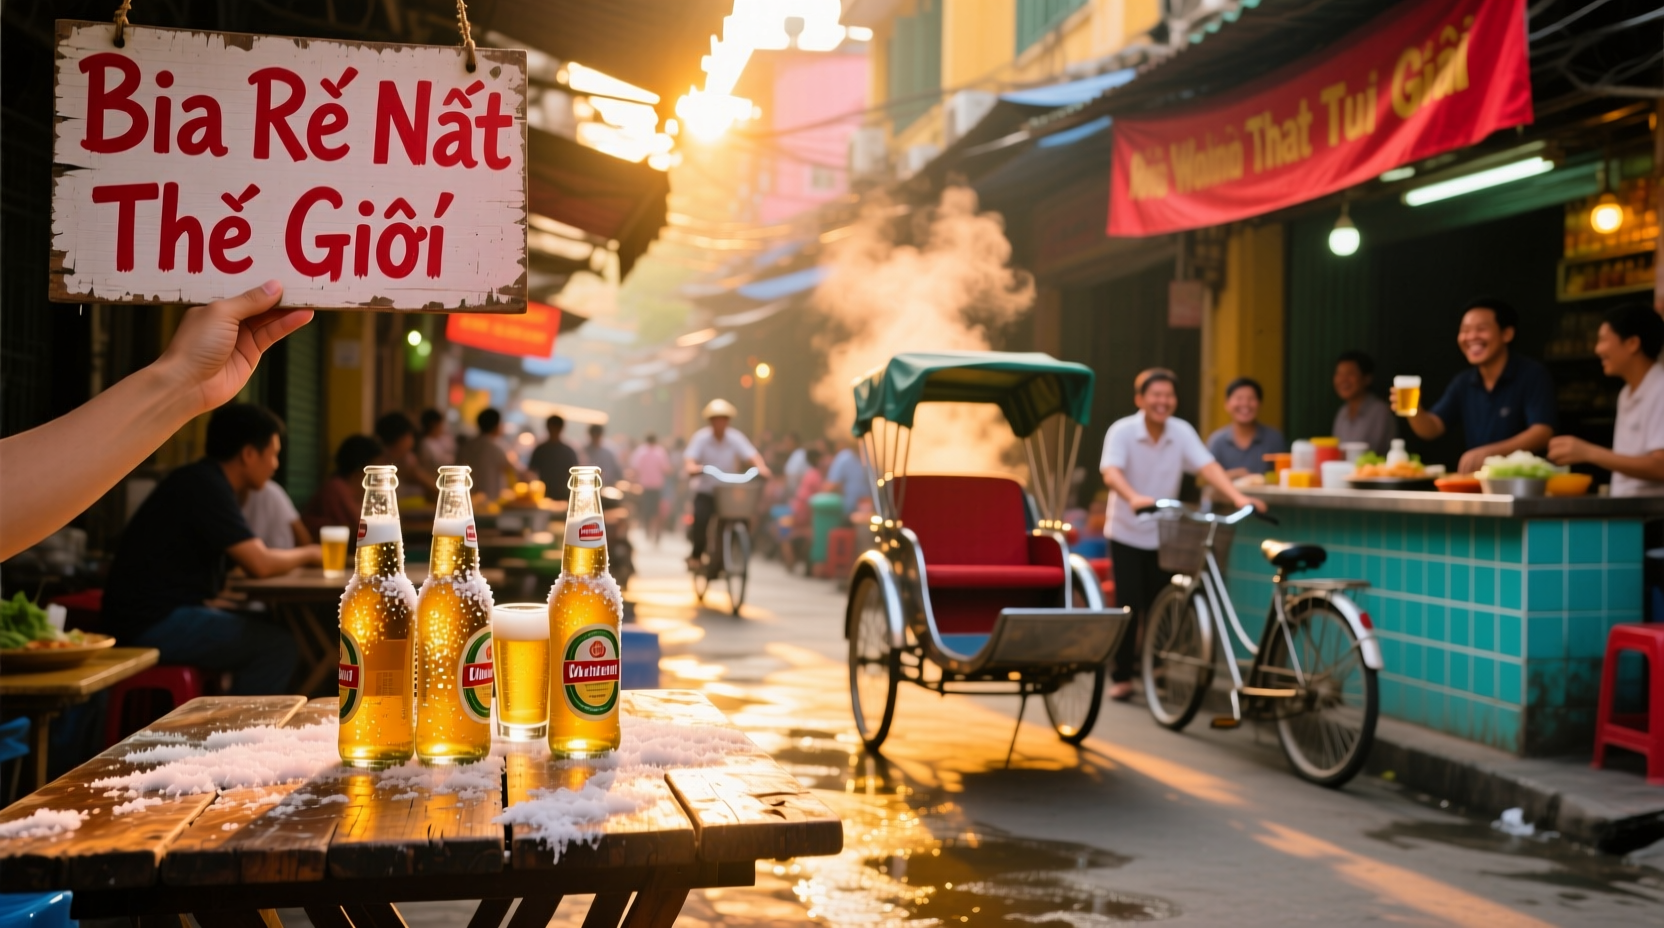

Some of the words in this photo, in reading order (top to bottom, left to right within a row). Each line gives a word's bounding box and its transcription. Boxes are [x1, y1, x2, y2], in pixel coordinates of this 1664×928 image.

[79, 52, 229, 158] Bia
[373, 79, 513, 171] Nất
[1245, 97, 1314, 174] That
